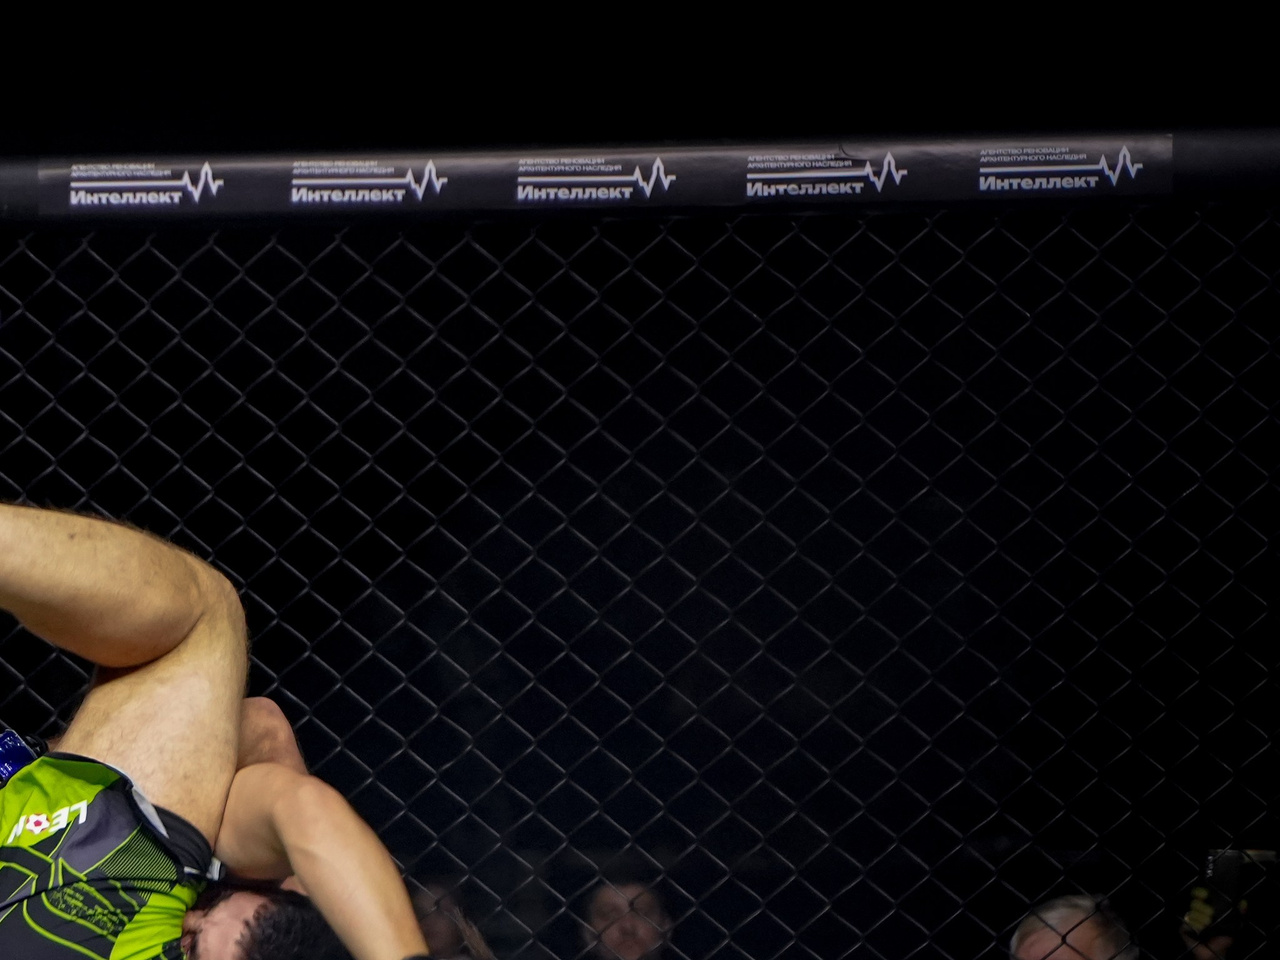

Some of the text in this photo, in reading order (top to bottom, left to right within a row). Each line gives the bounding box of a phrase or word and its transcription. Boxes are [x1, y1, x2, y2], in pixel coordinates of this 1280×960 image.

[747, 182, 864, 196] Интеллект
[980, 176, 1099, 190] Интеллект
[70, 190, 182, 205] Интеллект
[291, 188, 405, 203] Интеллект
[518, 185, 633, 200] Интеллект
